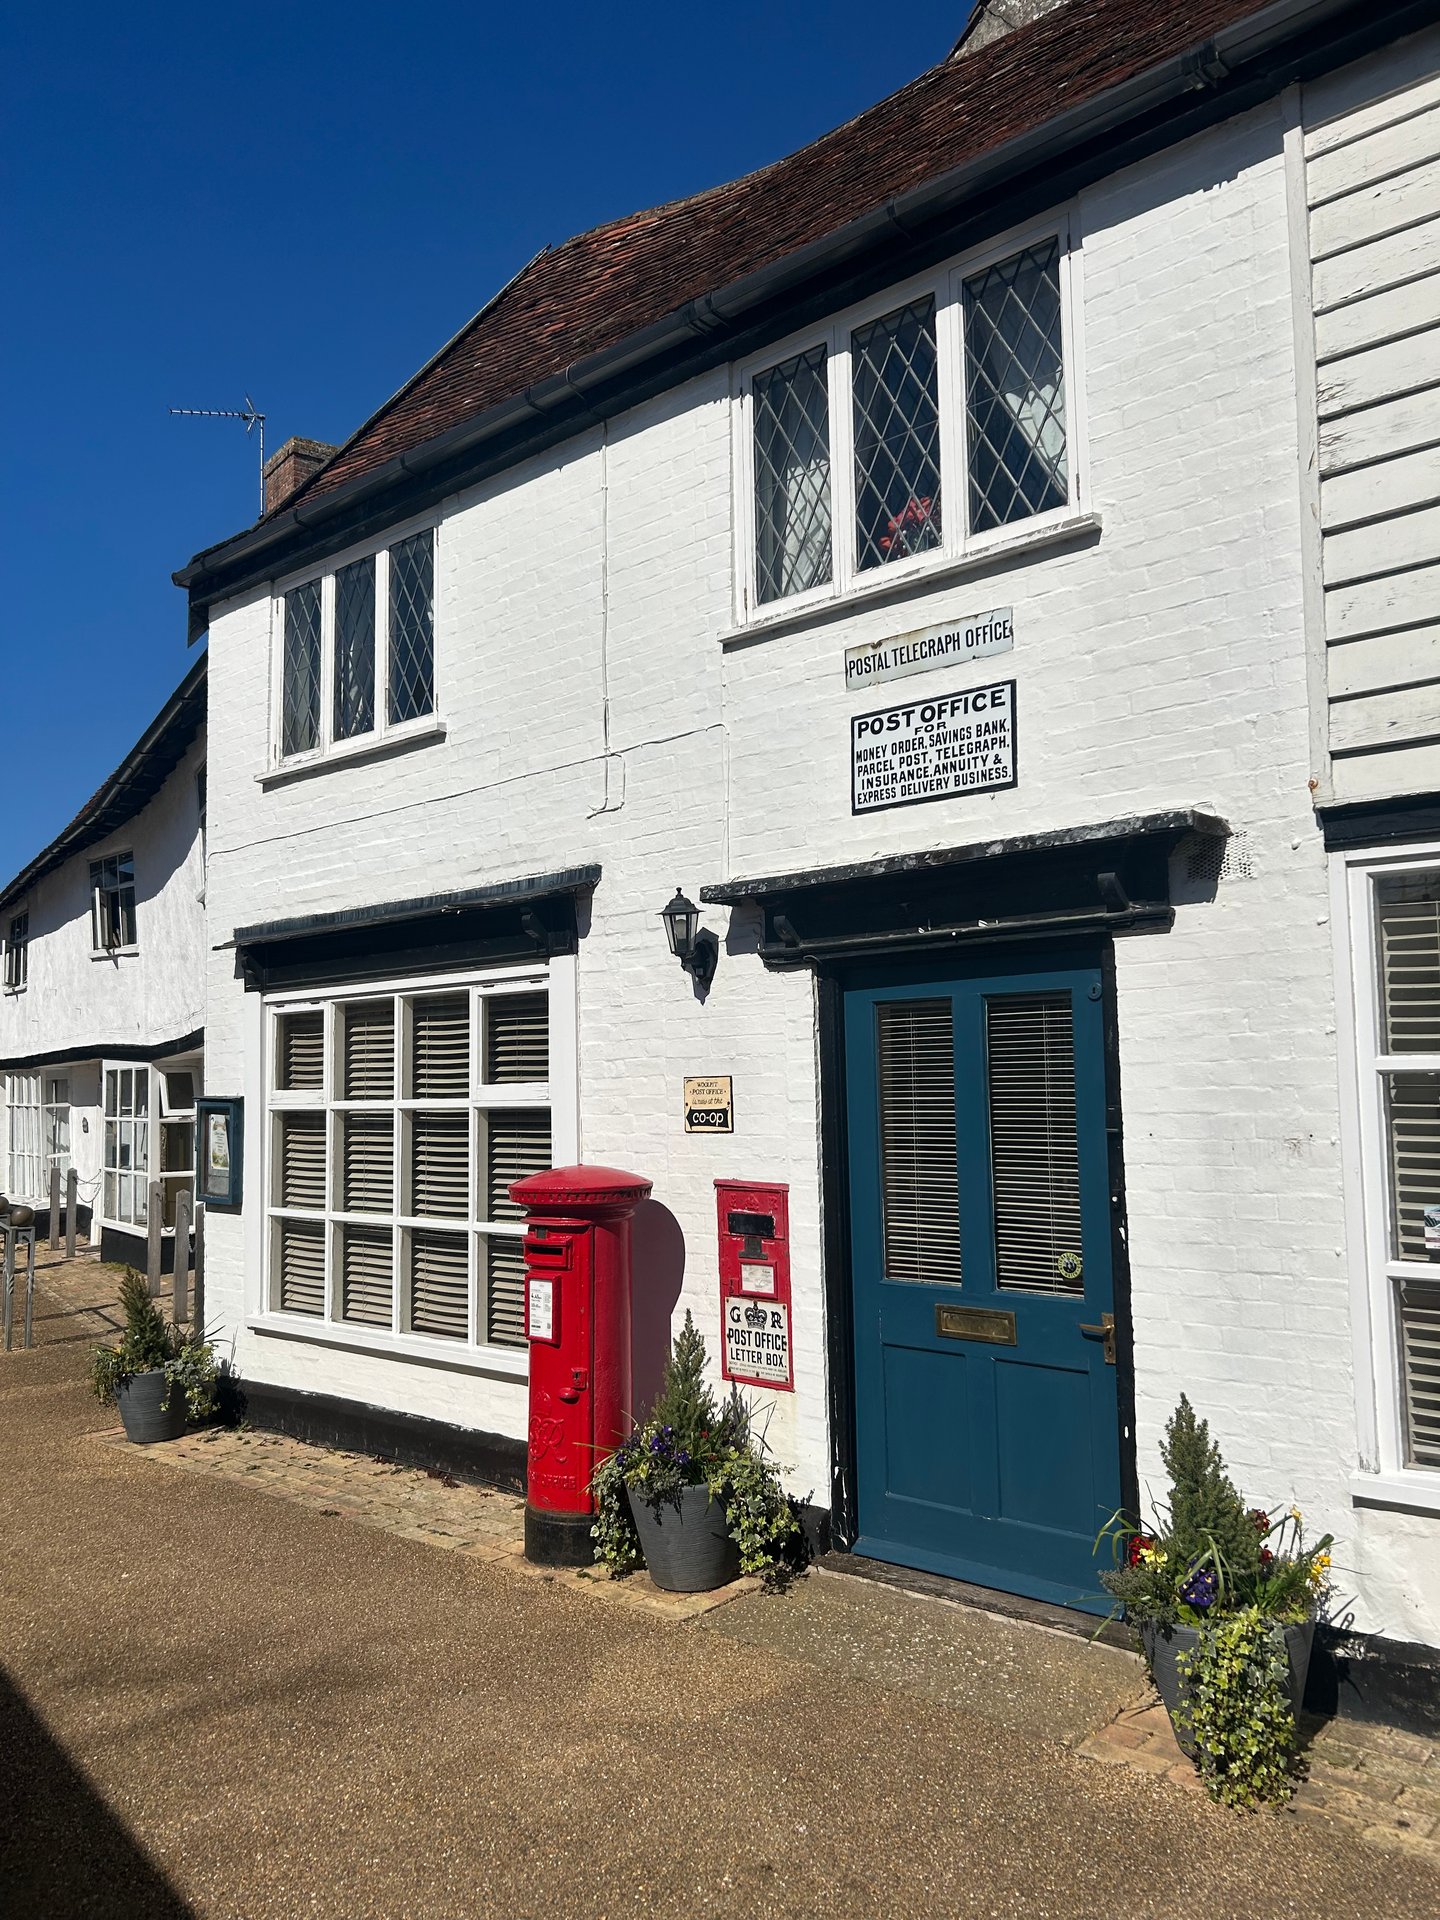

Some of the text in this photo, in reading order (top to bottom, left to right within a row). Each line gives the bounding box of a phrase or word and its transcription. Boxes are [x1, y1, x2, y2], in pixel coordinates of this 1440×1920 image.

[849, 620, 1010, 678] POSTAL TELEGRAPH OFFICE
[857, 689, 1006, 739] POST OFFICE
[914, 721, 947, 736] FOR
[856, 744, 887, 763] MONEY
[929, 725, 972, 747] SAVINGS
[857, 758, 895, 777] PARCEL
[899, 752, 933, 769] POST,
[933, 755, 989, 778] ANNUITY
[993, 753, 1003, 765] &
[857, 766, 1012, 805] EXPRESS DELIVERY BUSINESS.
[730, 1306, 784, 1329] G R
[728, 1328, 787, 1352] POST OFFICE
[730, 1347, 762, 1364] LETTER
[766, 1353, 787, 1368] BOX.
